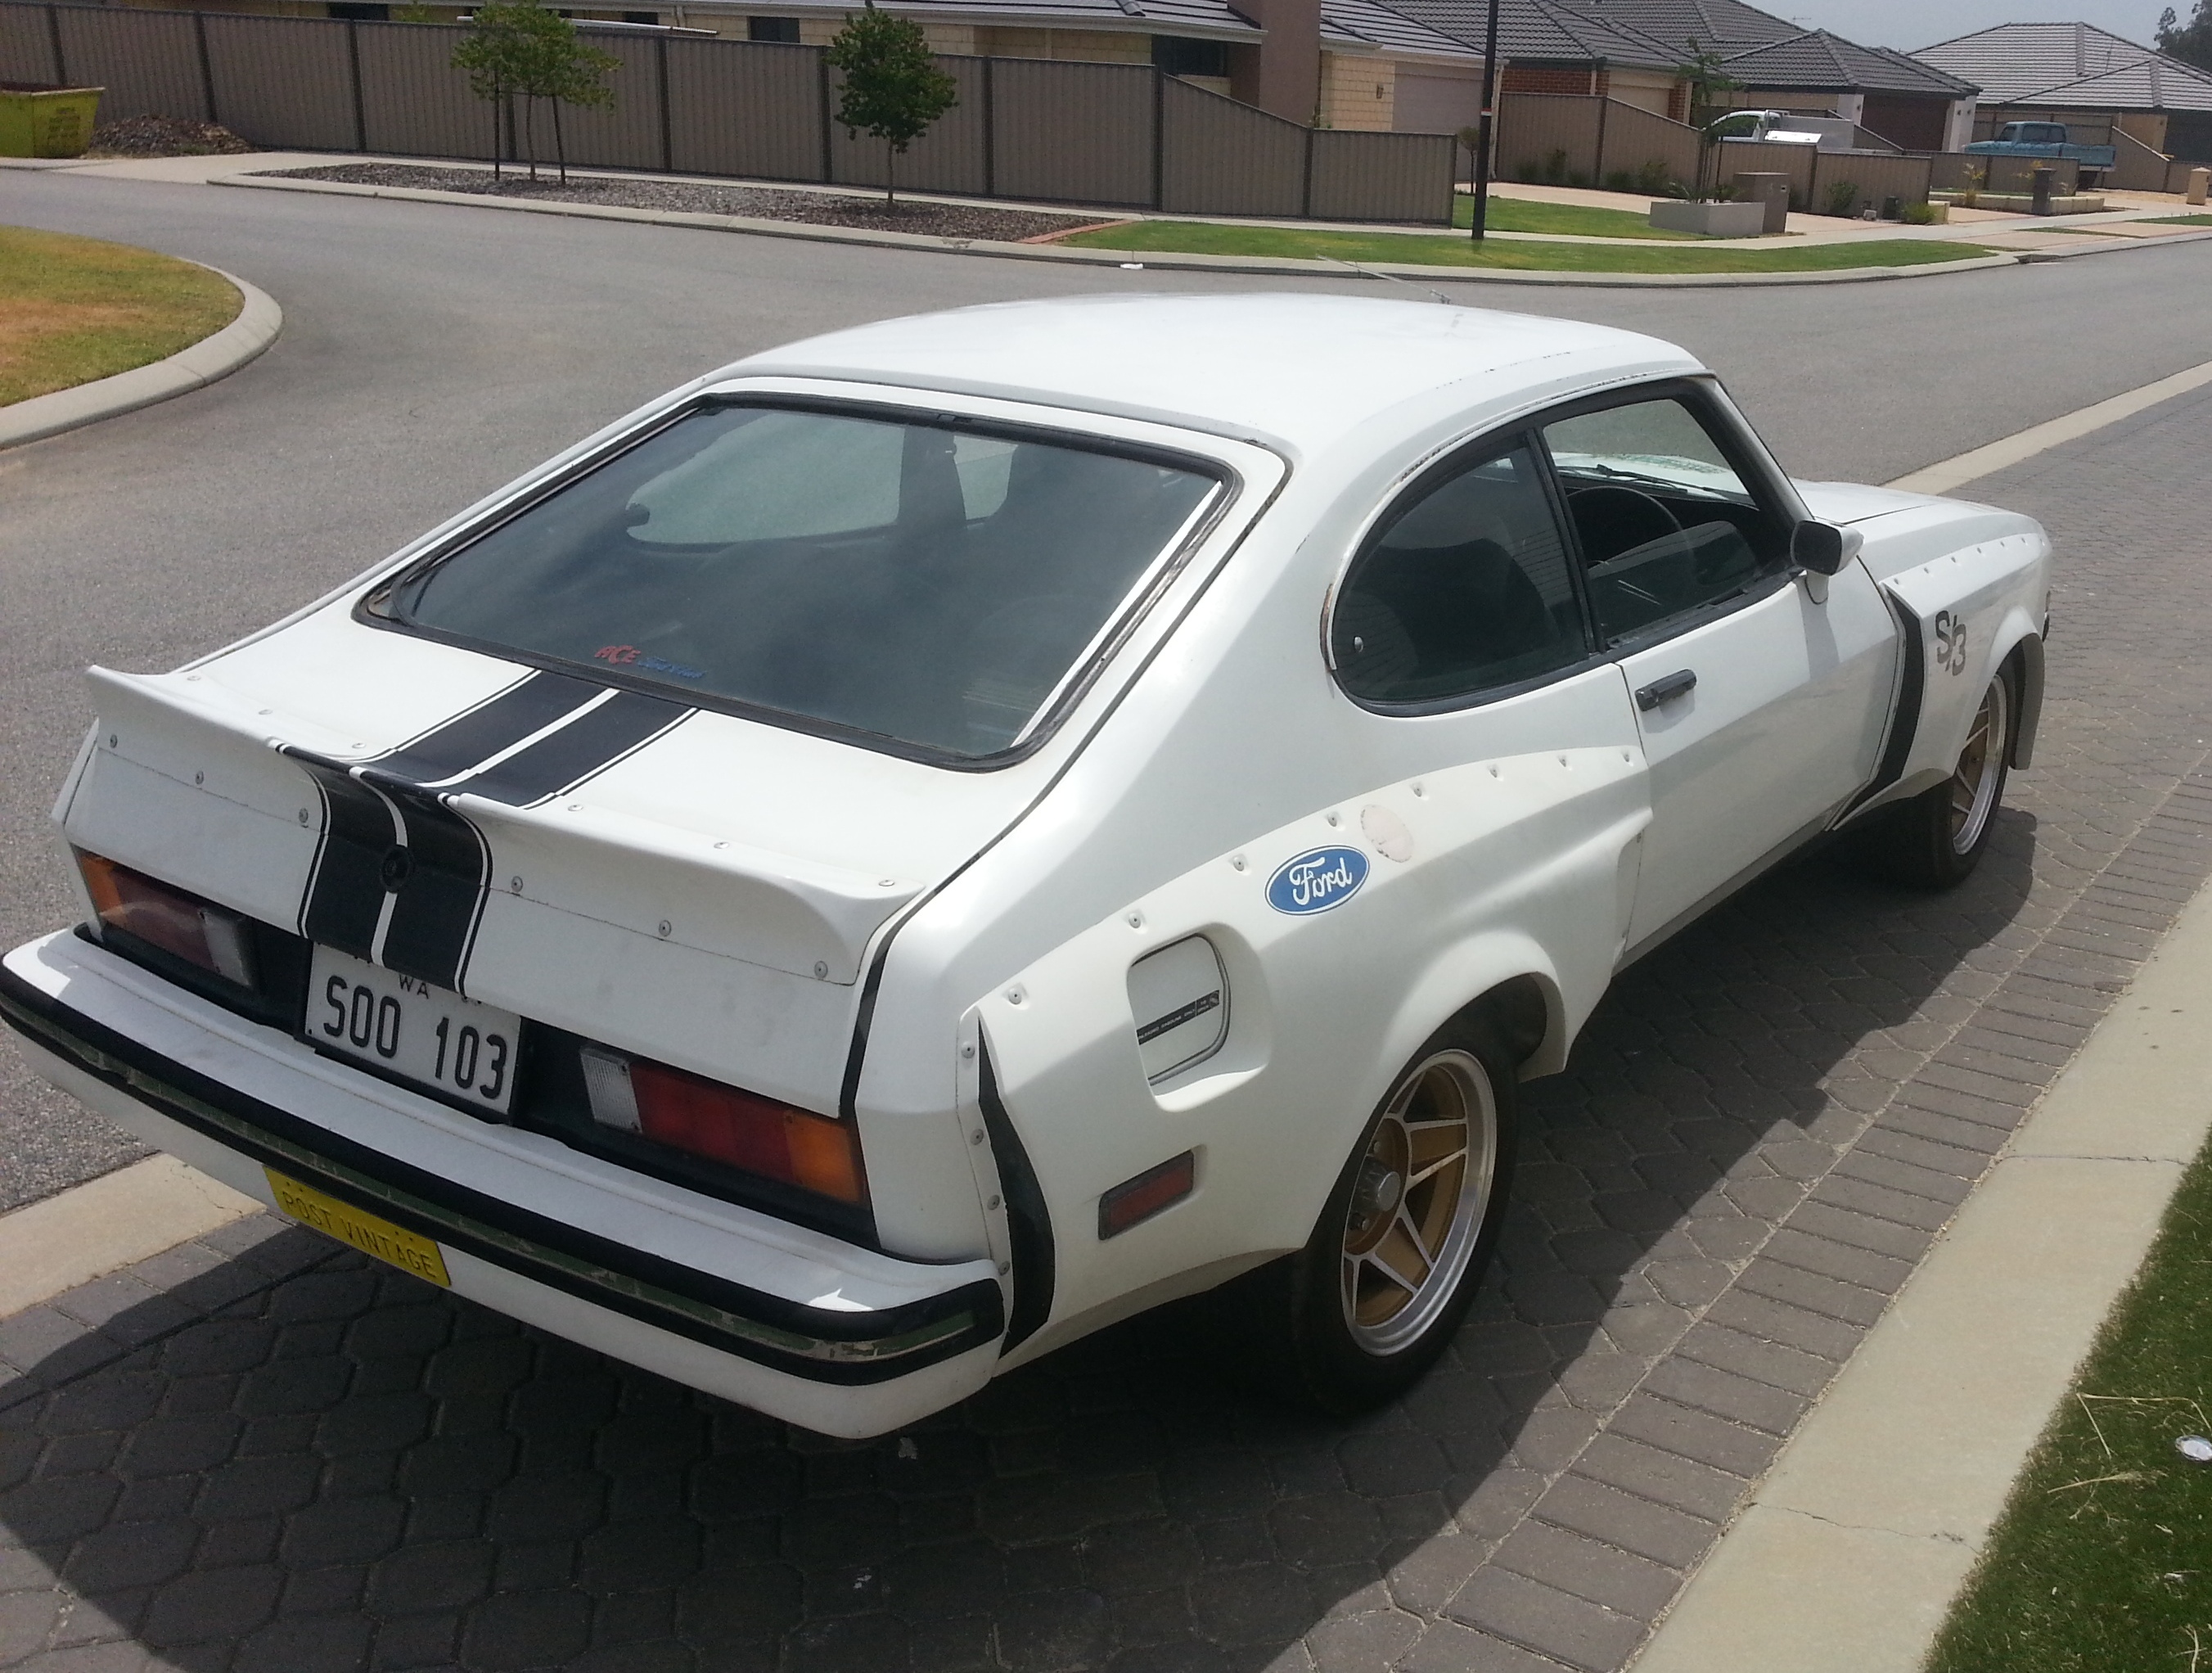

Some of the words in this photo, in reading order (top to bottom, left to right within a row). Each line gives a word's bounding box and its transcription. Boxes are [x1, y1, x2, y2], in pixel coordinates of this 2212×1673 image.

[1289, 856, 1353, 905] Ford
[399, 974, 430, 999] WA
[435, 1017, 507, 1099] 103
[282, 1191, 331, 1229] POST
[340, 1215, 437, 1278] VINTAGE
